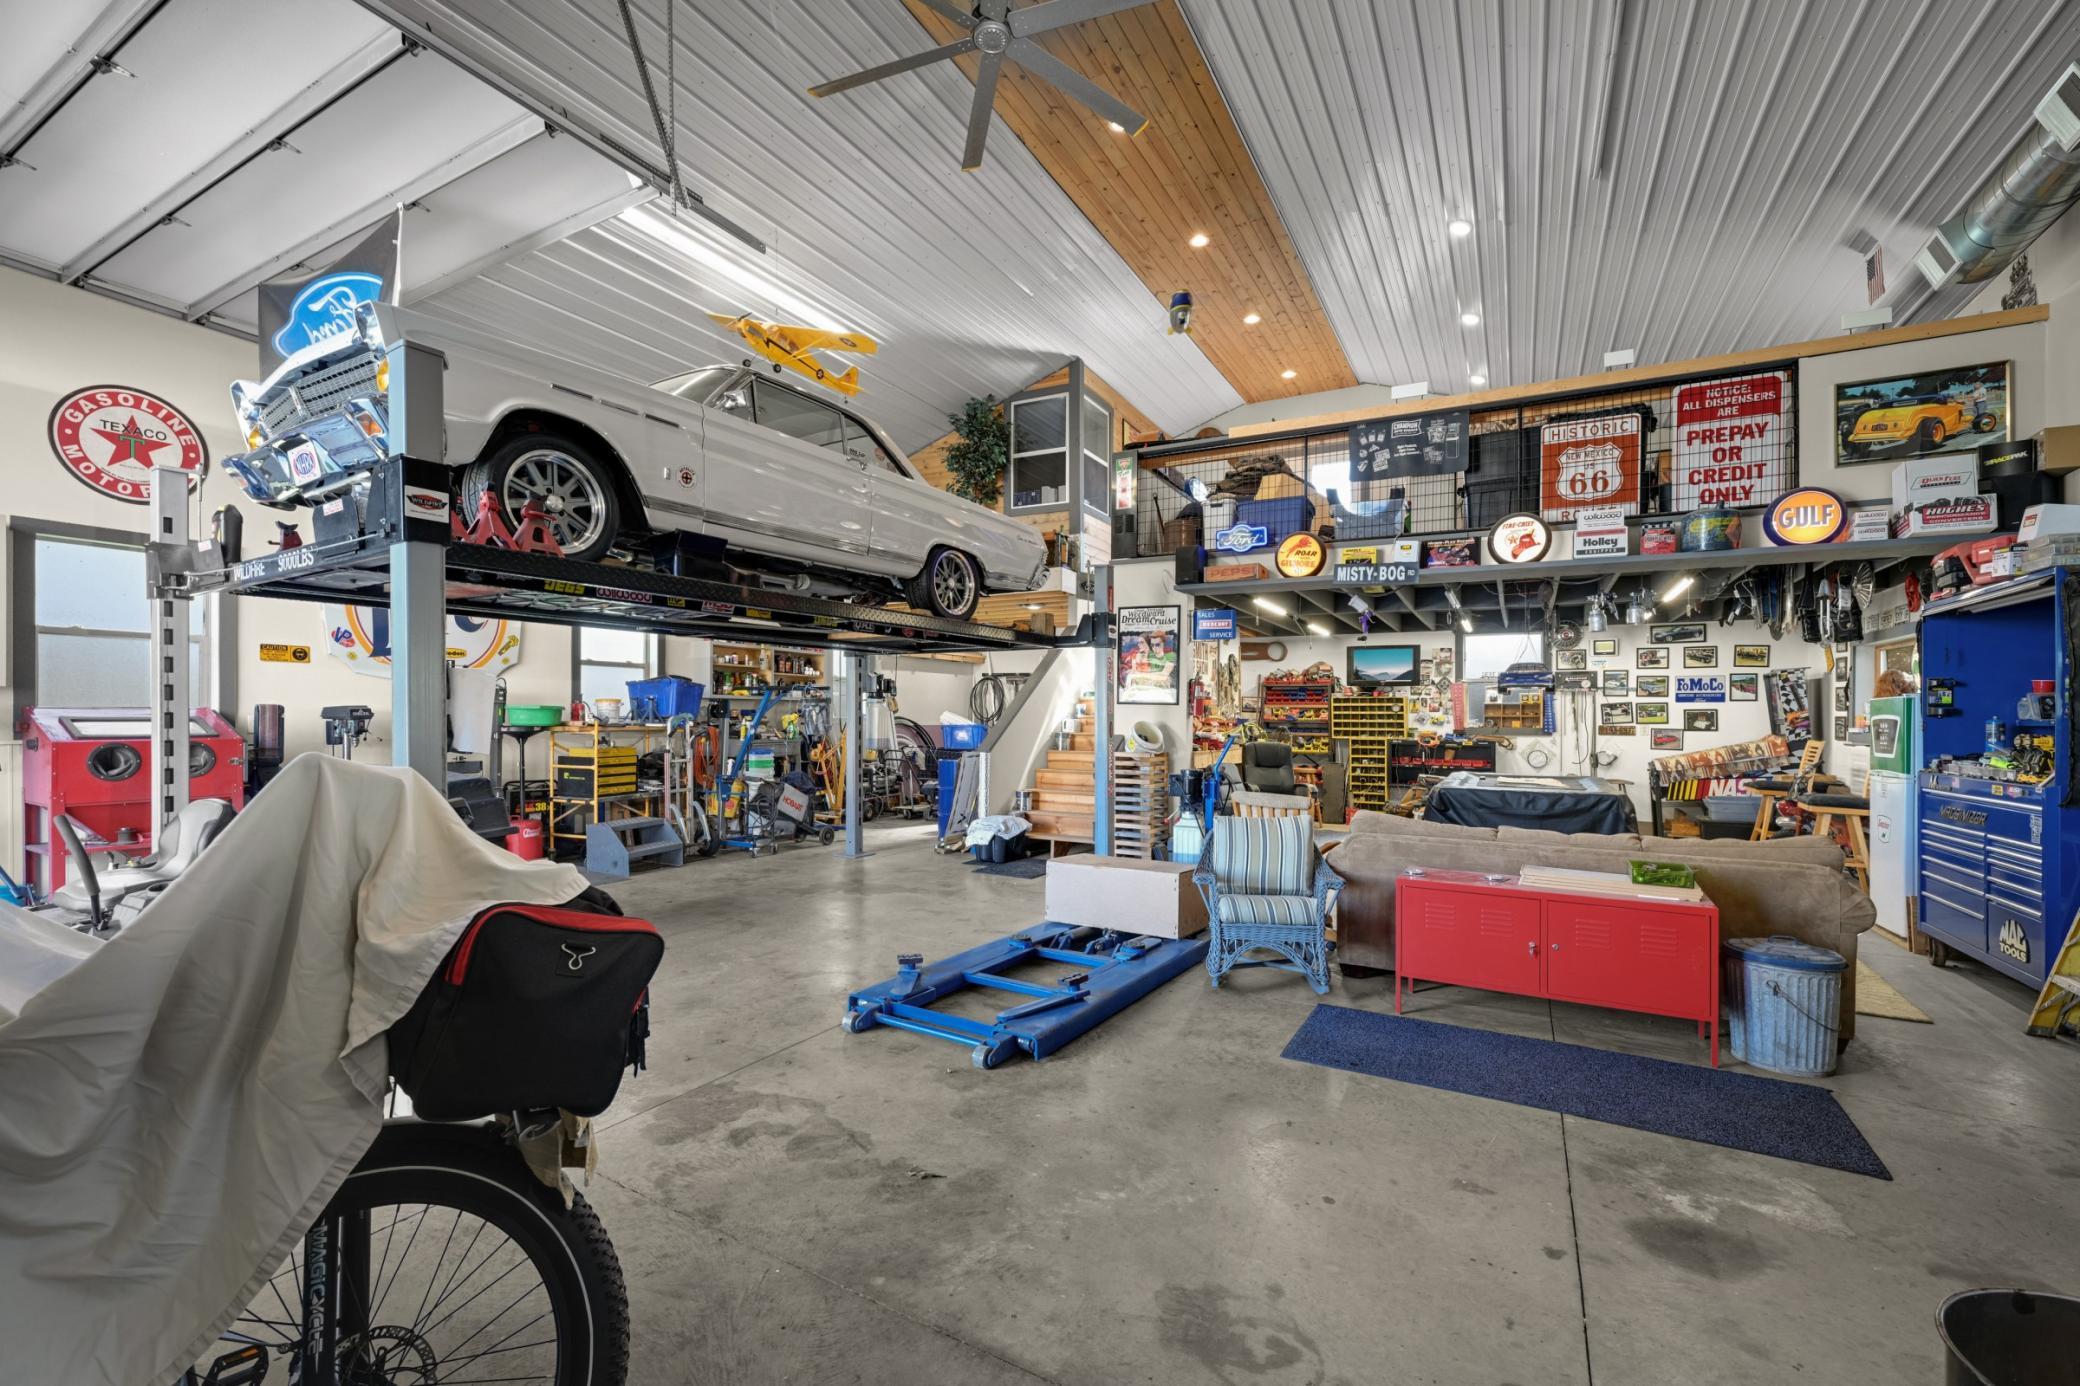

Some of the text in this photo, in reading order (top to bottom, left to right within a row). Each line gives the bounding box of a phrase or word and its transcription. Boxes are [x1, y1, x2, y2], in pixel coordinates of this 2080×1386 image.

[1706, 384, 1752, 398] NOTICE:
[1682, 390, 1776, 412] ALL DISPENSERS
[64, 392, 196, 447] GASOLINE
[1717, 405, 1740, 417] ARE
[99, 419, 167, 441] TEXACO
[1393, 421, 1419, 429] CHAMPION
[1551, 420, 1629, 440] HISTORIC
[1686, 421, 1769, 447] PREPAY
[1566, 448, 1614, 460] NEW MEXICO
[1712, 445, 1743, 464] OR
[1569, 470, 1609, 495] 66
[1688, 463, 1767, 485] CREDIT
[1699, 484, 1755, 504] ONLY
[1779, 504, 1835, 530] GULF
[1926, 504, 1985, 515] HUGHES
[1222, 532, 1260, 547] Ford
[1583, 538, 1618, 548] Holley
[1294, 549, 1318, 557] ROAR
[1121, 614, 1177, 625] Dream Cruise
[1127, 610, 1166, 619] Woodward
[1676, 677, 1724, 691] FoMoCo
[1999, 919, 2027, 952] MAC
[1999, 942, 2027, 963] TOOLS
